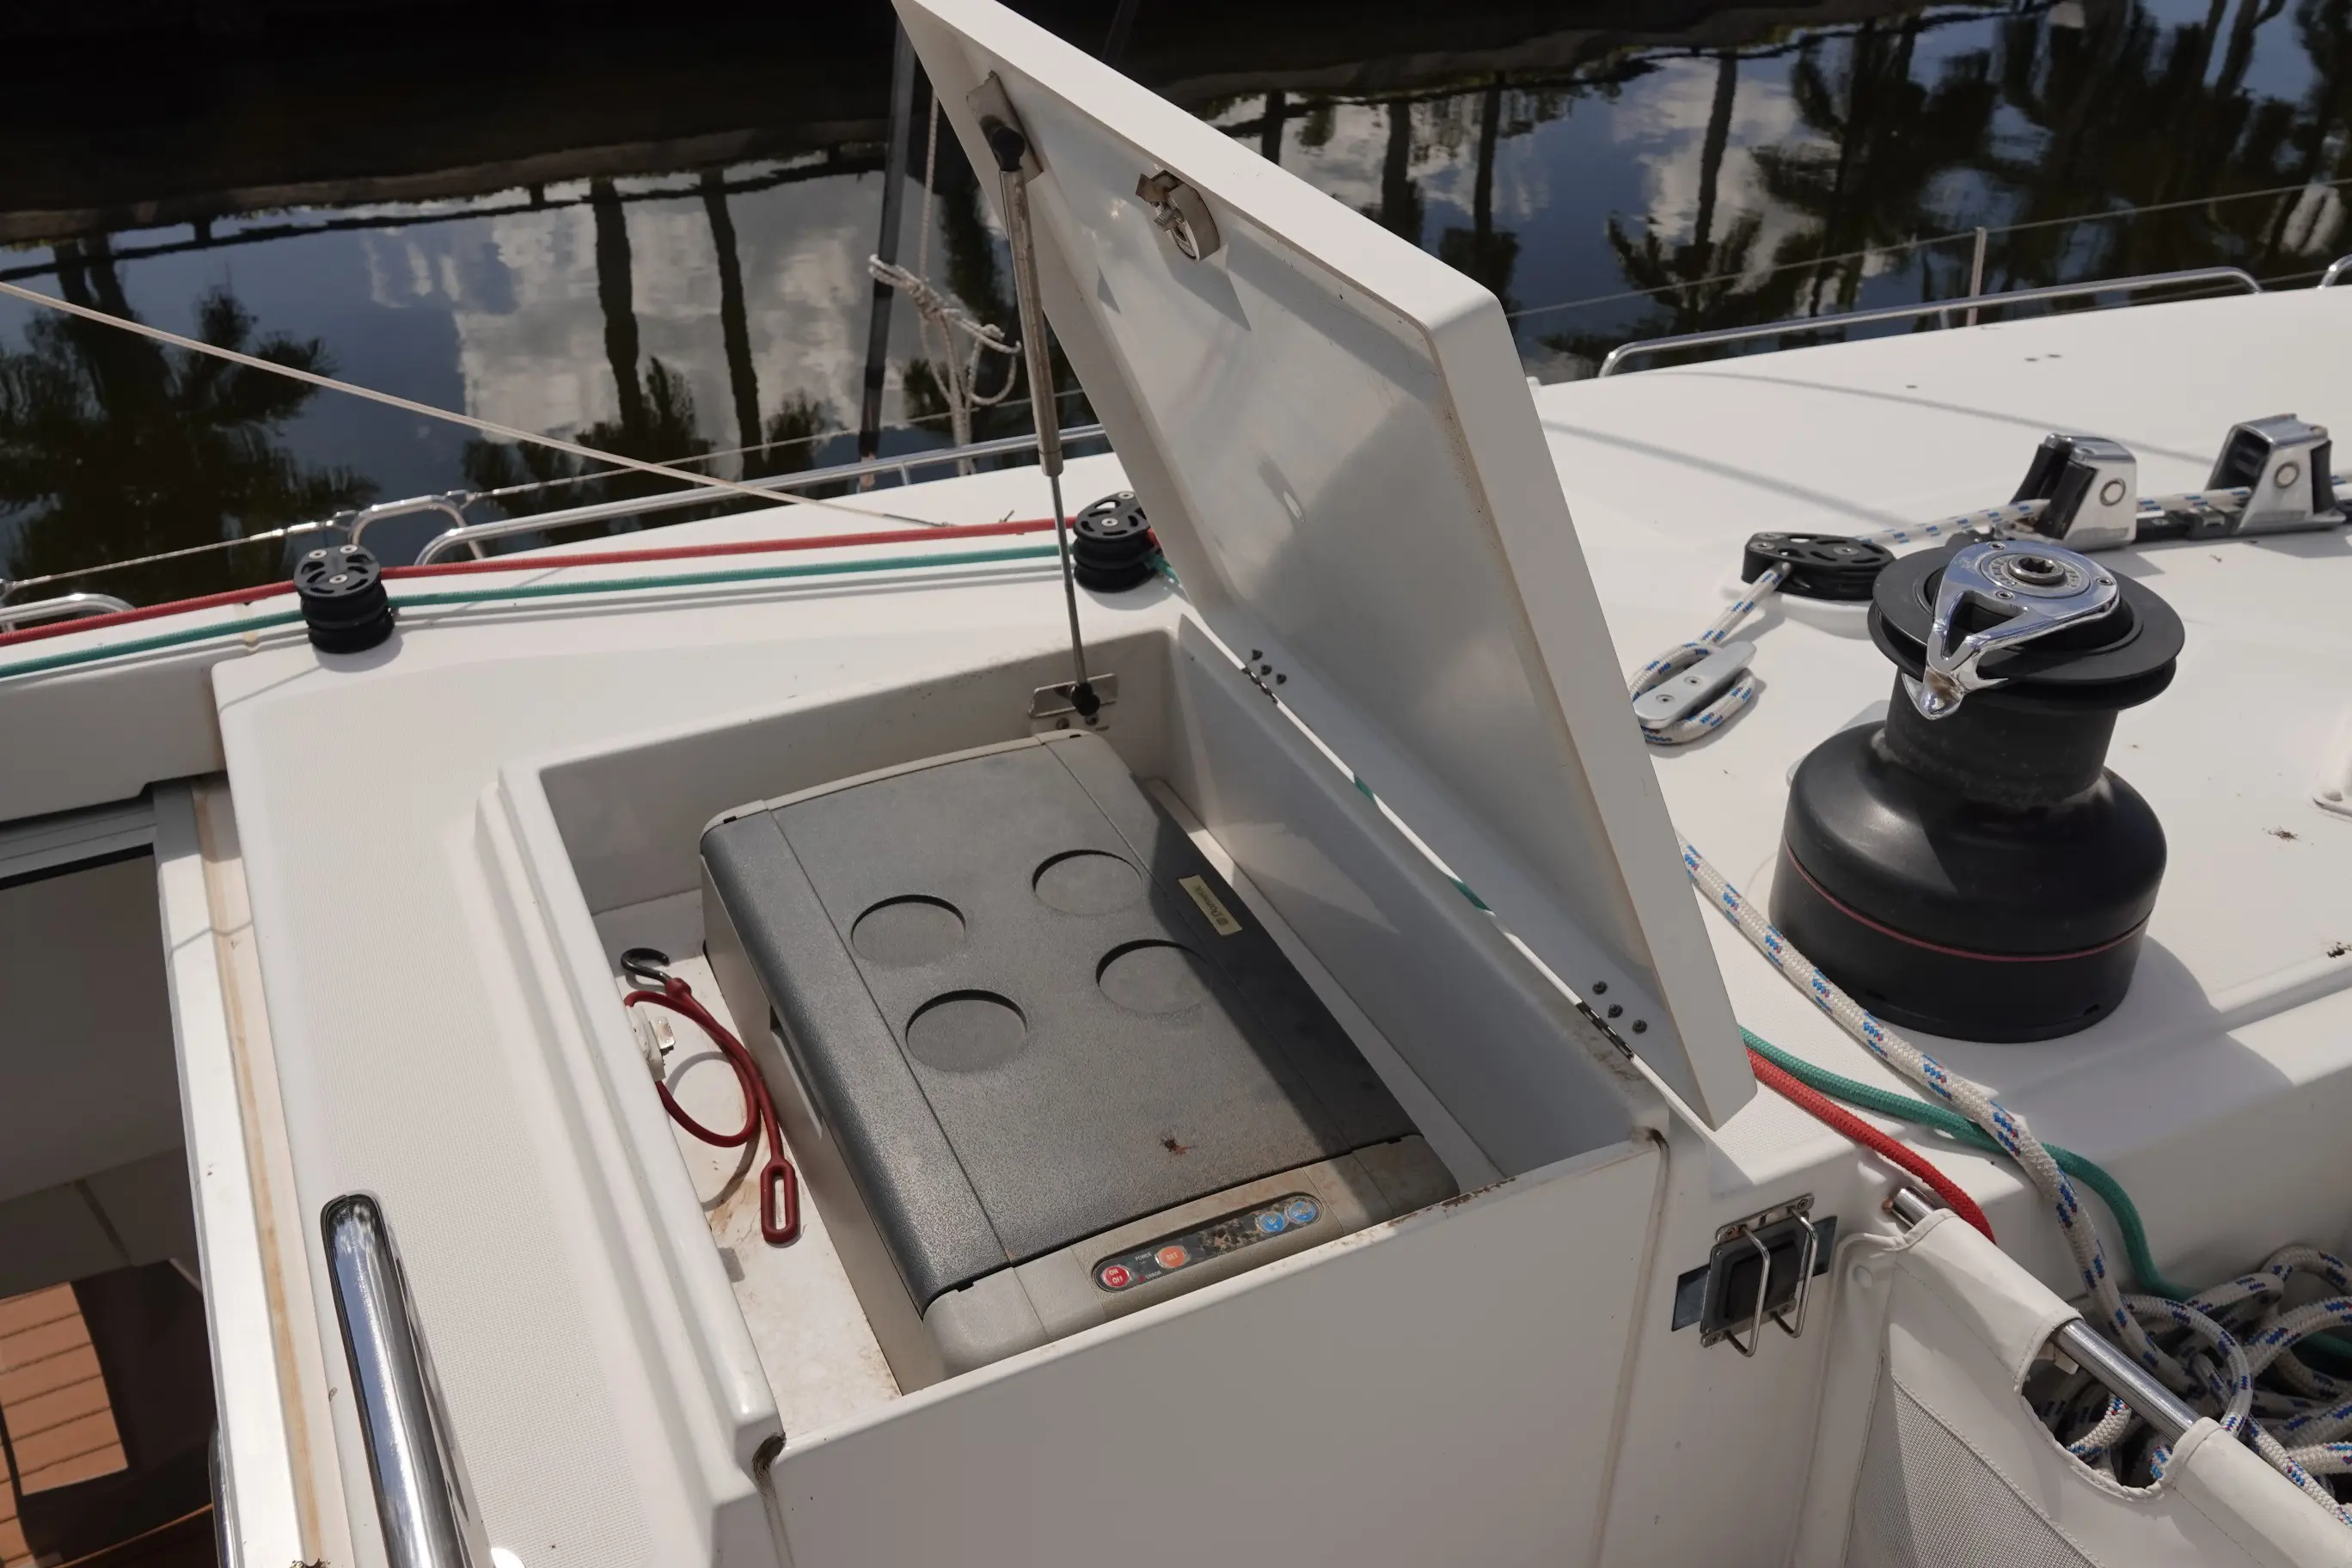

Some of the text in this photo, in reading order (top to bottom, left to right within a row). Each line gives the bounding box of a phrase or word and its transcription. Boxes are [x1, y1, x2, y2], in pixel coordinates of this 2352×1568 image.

[1135, 1252, 1152, 1261] POWER
[1112, 1276, 1124, 1284] OFF
[1146, 1271, 1162, 1280] ERROR
